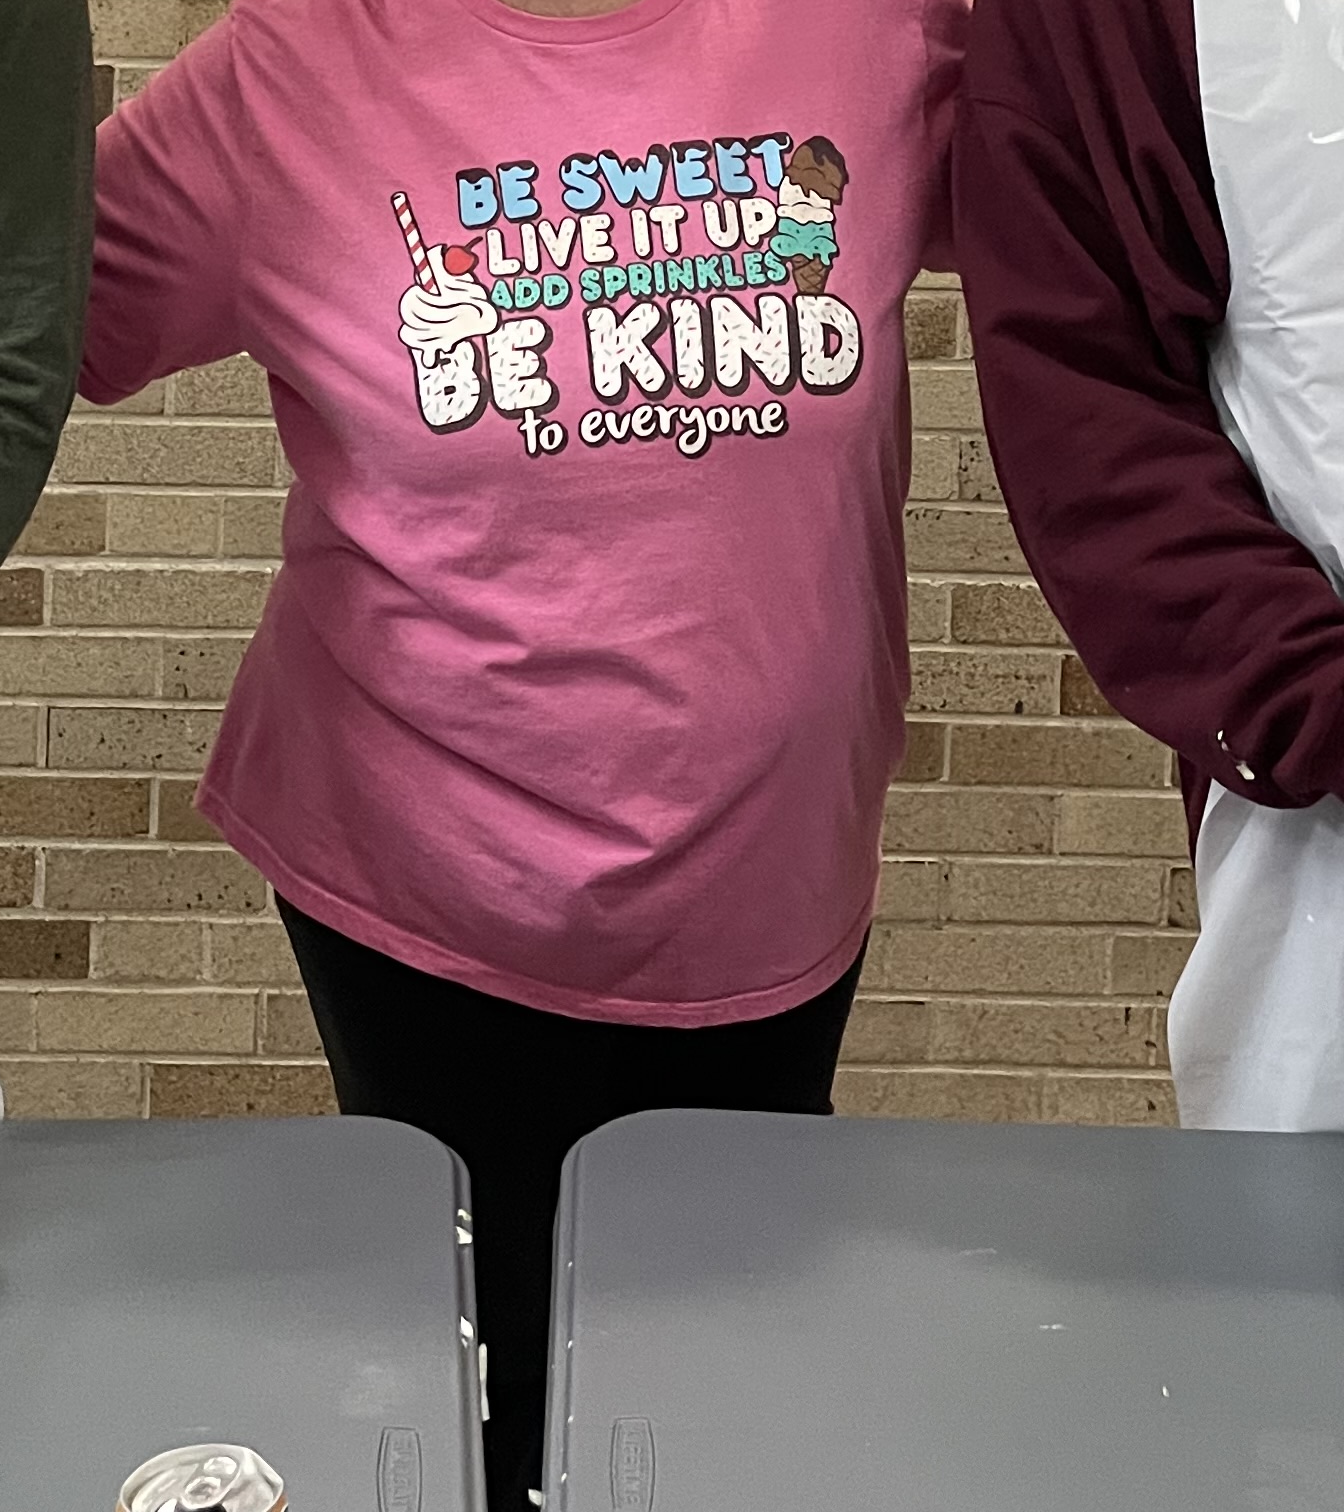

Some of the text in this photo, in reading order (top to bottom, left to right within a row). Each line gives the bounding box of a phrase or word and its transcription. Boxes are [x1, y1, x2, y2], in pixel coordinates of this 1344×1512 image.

[456, 132, 792, 229] BE SWEET
[485, 196, 779, 276] LIVE IT UP
[489, 251, 790, 311] ADD SPRINKLES
[410, 294, 863, 434] BE KIND
[519, 401, 789, 458] to everyone
